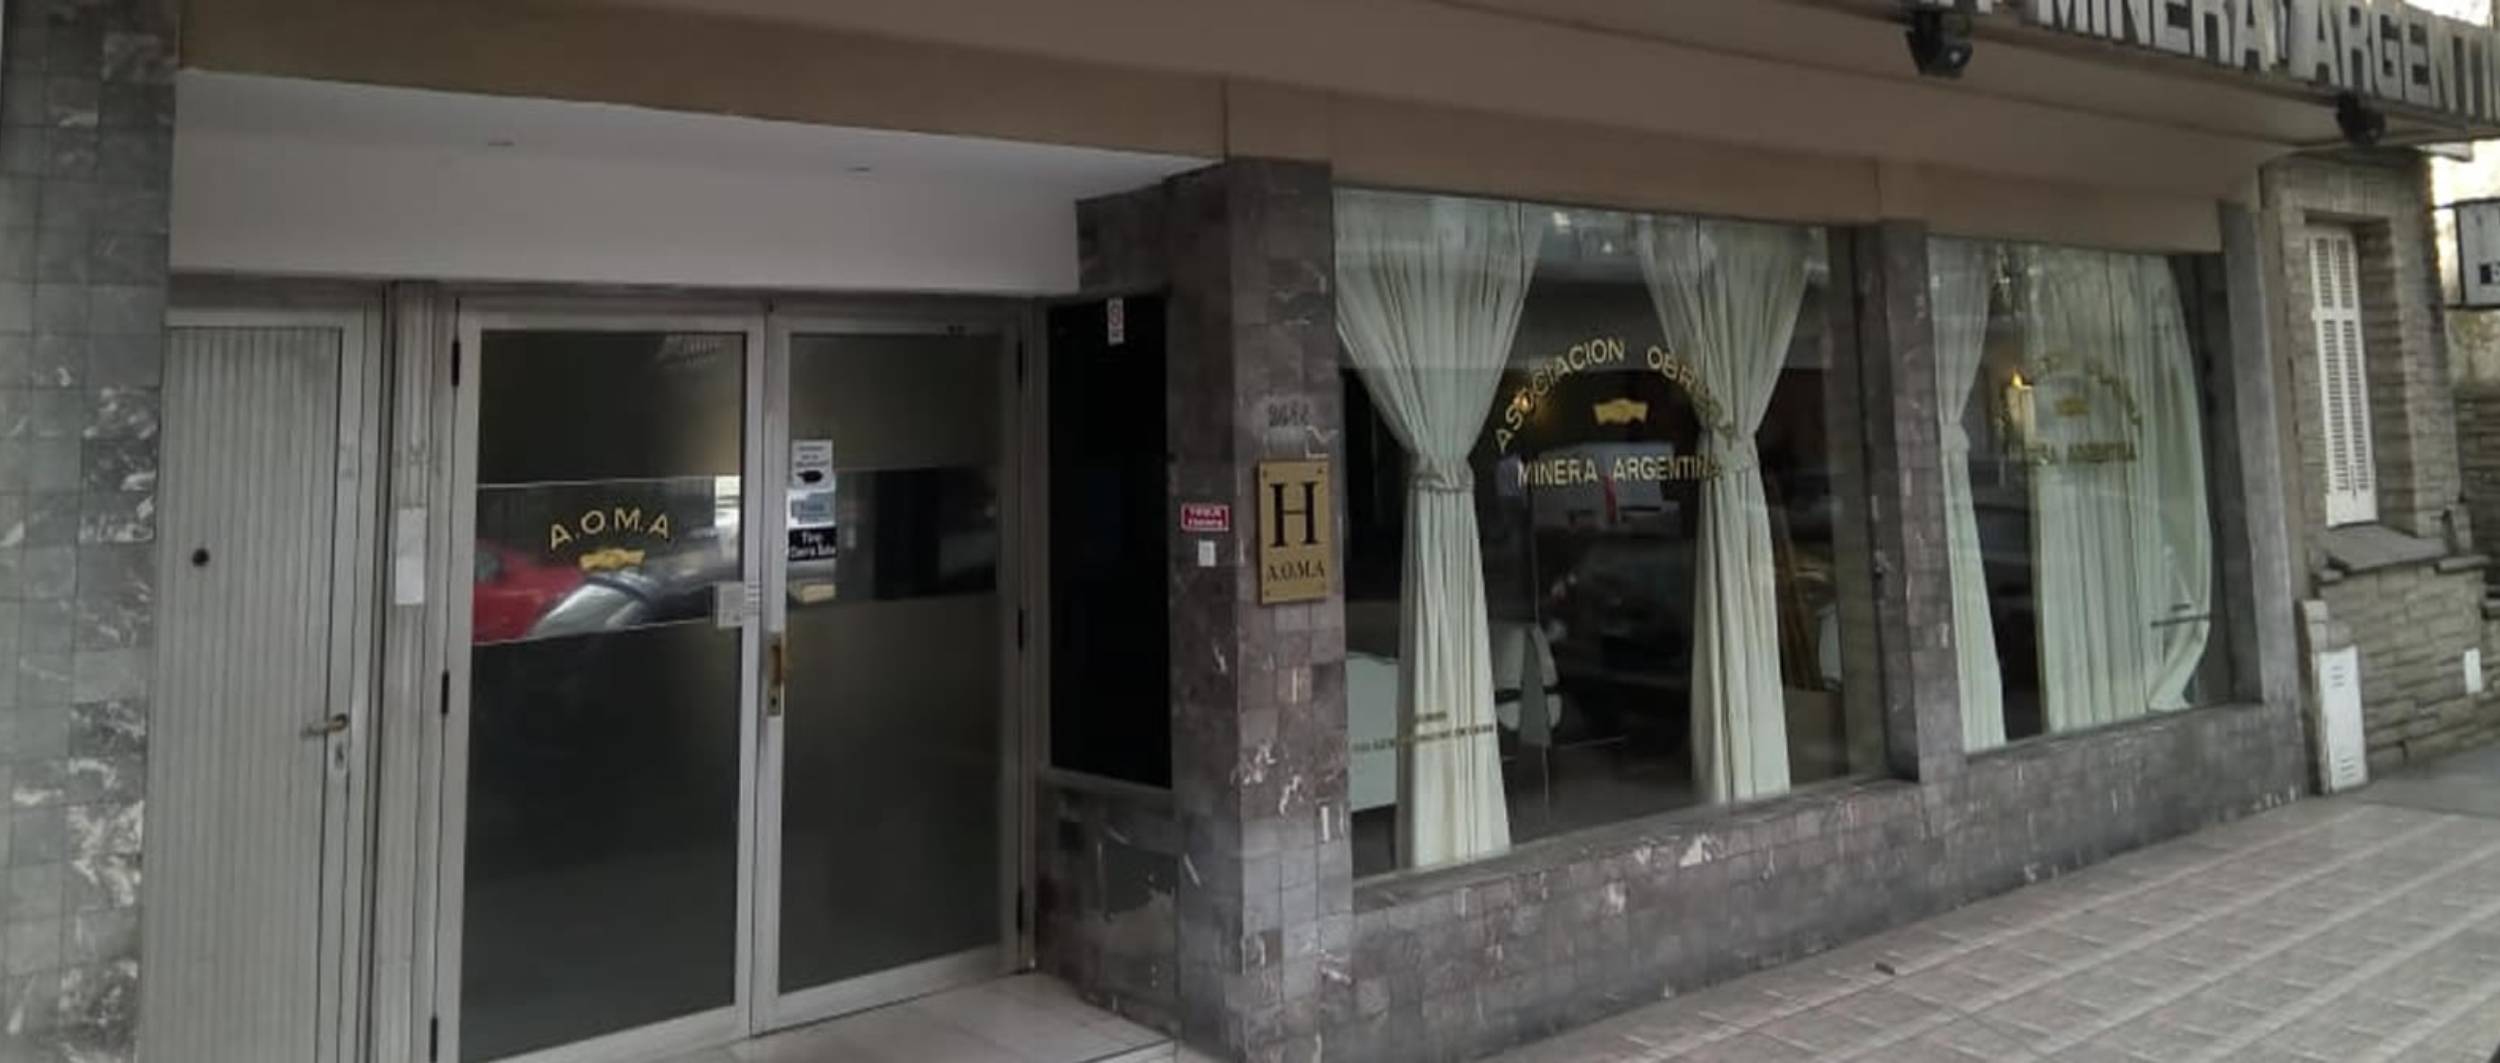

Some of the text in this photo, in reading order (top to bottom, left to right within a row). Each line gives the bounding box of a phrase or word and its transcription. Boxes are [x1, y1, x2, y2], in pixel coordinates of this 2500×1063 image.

[2036, 0, 2500, 121] MINERA ARGENTI
[1492, 338, 1626, 454] ASOCIACION
[1269, 481, 1319, 548] H
[1517, 460, 1600, 487] MINERA
